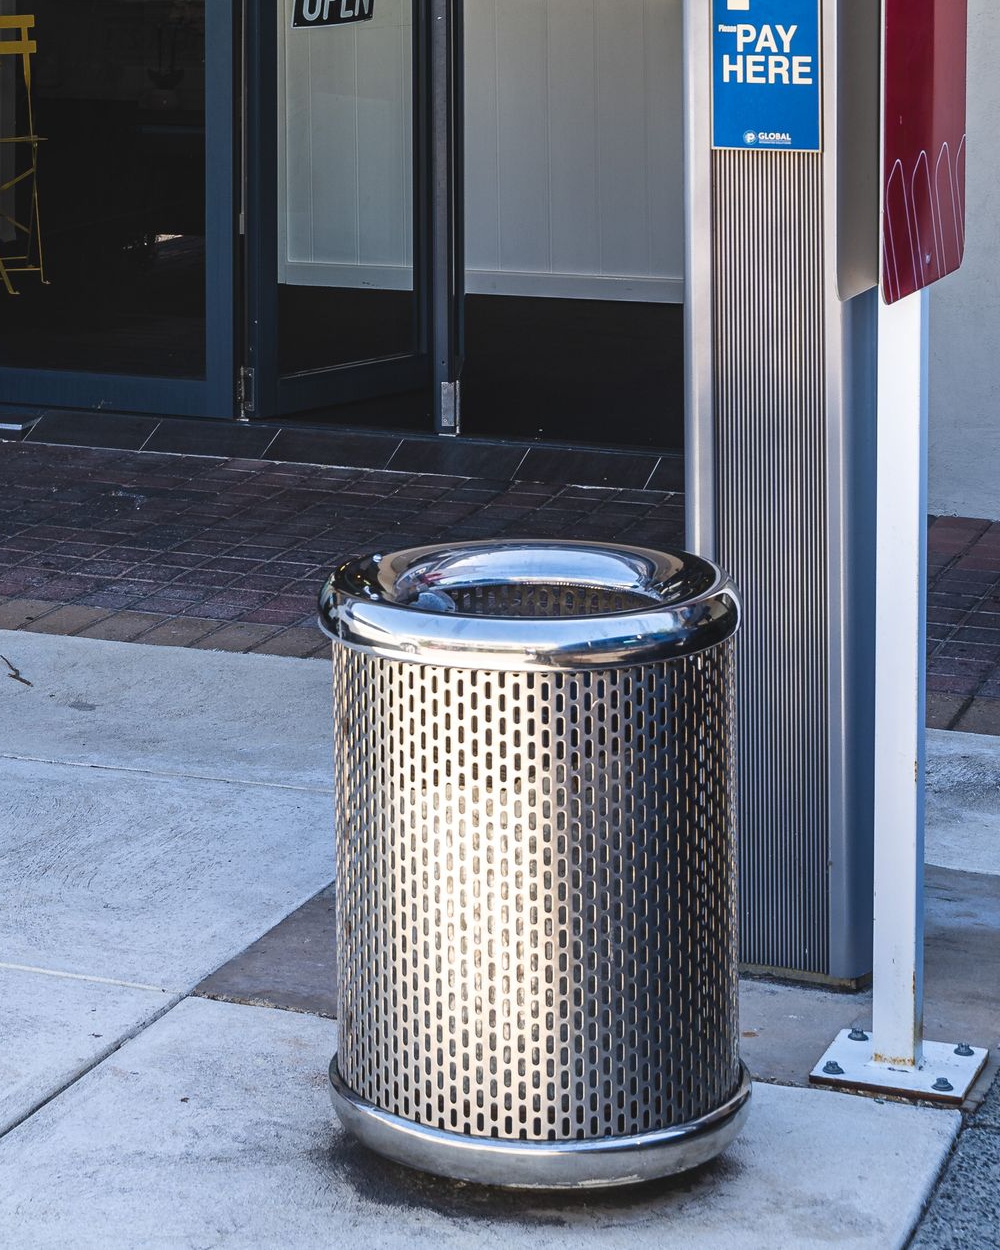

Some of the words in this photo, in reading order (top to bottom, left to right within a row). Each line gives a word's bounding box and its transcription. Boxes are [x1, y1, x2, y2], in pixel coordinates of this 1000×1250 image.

[736, 24, 797, 53] PAY
[722, 55, 813, 85] HERE
[758, 132, 792, 140] GLOBAL
